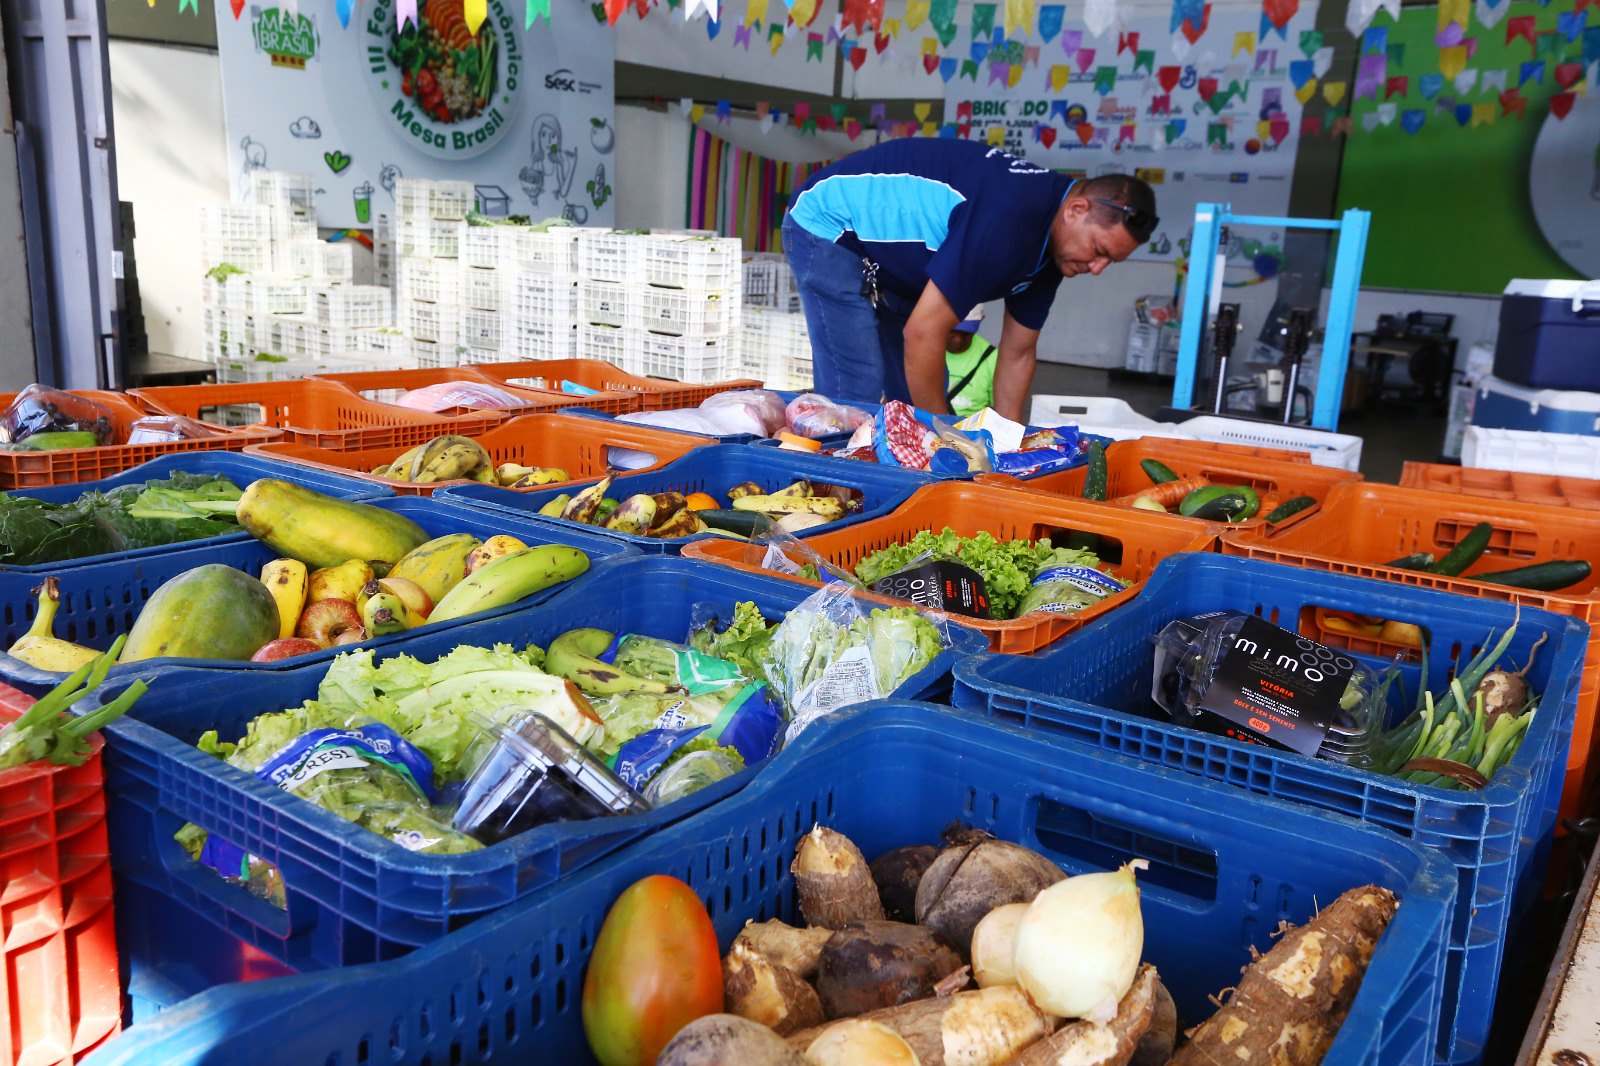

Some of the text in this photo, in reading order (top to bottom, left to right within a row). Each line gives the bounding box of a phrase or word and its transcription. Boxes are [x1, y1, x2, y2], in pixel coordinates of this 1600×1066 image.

[260, 12, 312, 38] MESA
[260, 30, 313, 56] BRASIL
[487, 0, 522, 92] nômico
[391, 99, 505, 150] Mesa Brasil
[1234, 638, 1324, 683] mimo
[1260, 679, 1295, 698] VITÓRIA
